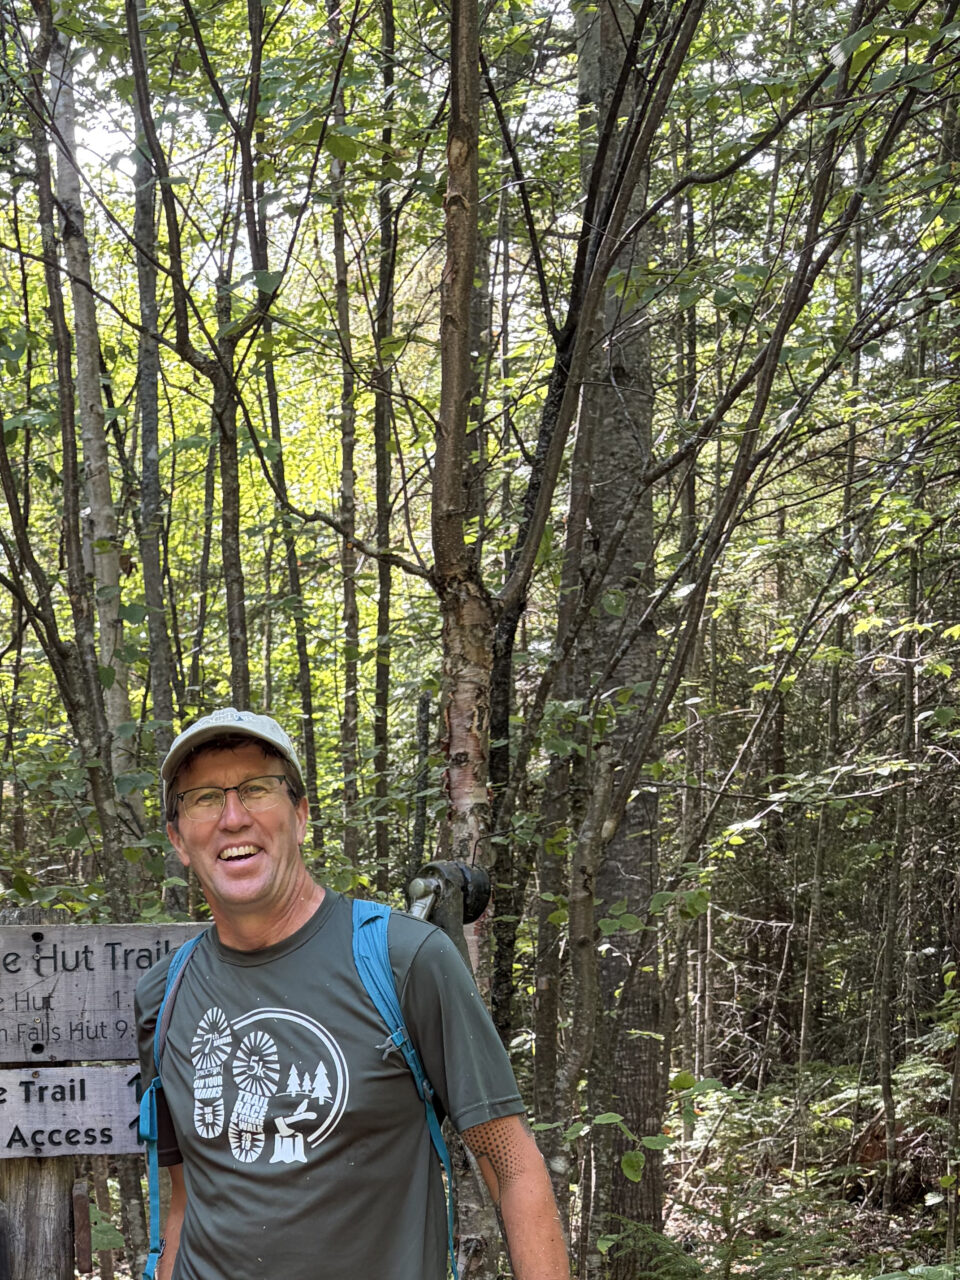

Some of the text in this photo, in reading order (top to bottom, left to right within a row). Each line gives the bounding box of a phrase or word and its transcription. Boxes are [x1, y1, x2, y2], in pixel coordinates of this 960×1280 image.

[34, 944, 94, 974] Hut
[14, 992, 55, 1012] Hut
[17, 1021, 61, 1042] Falls
[69, 1020, 108, 1041] Hut
[19, 1078, 86, 1104] Trail
[238, 1090, 270, 1108] TRAIL
[233, 1101, 269, 1120] RACE
[6, 1125, 113, 1149] Access
[238, 1120, 263, 1133] WALK
